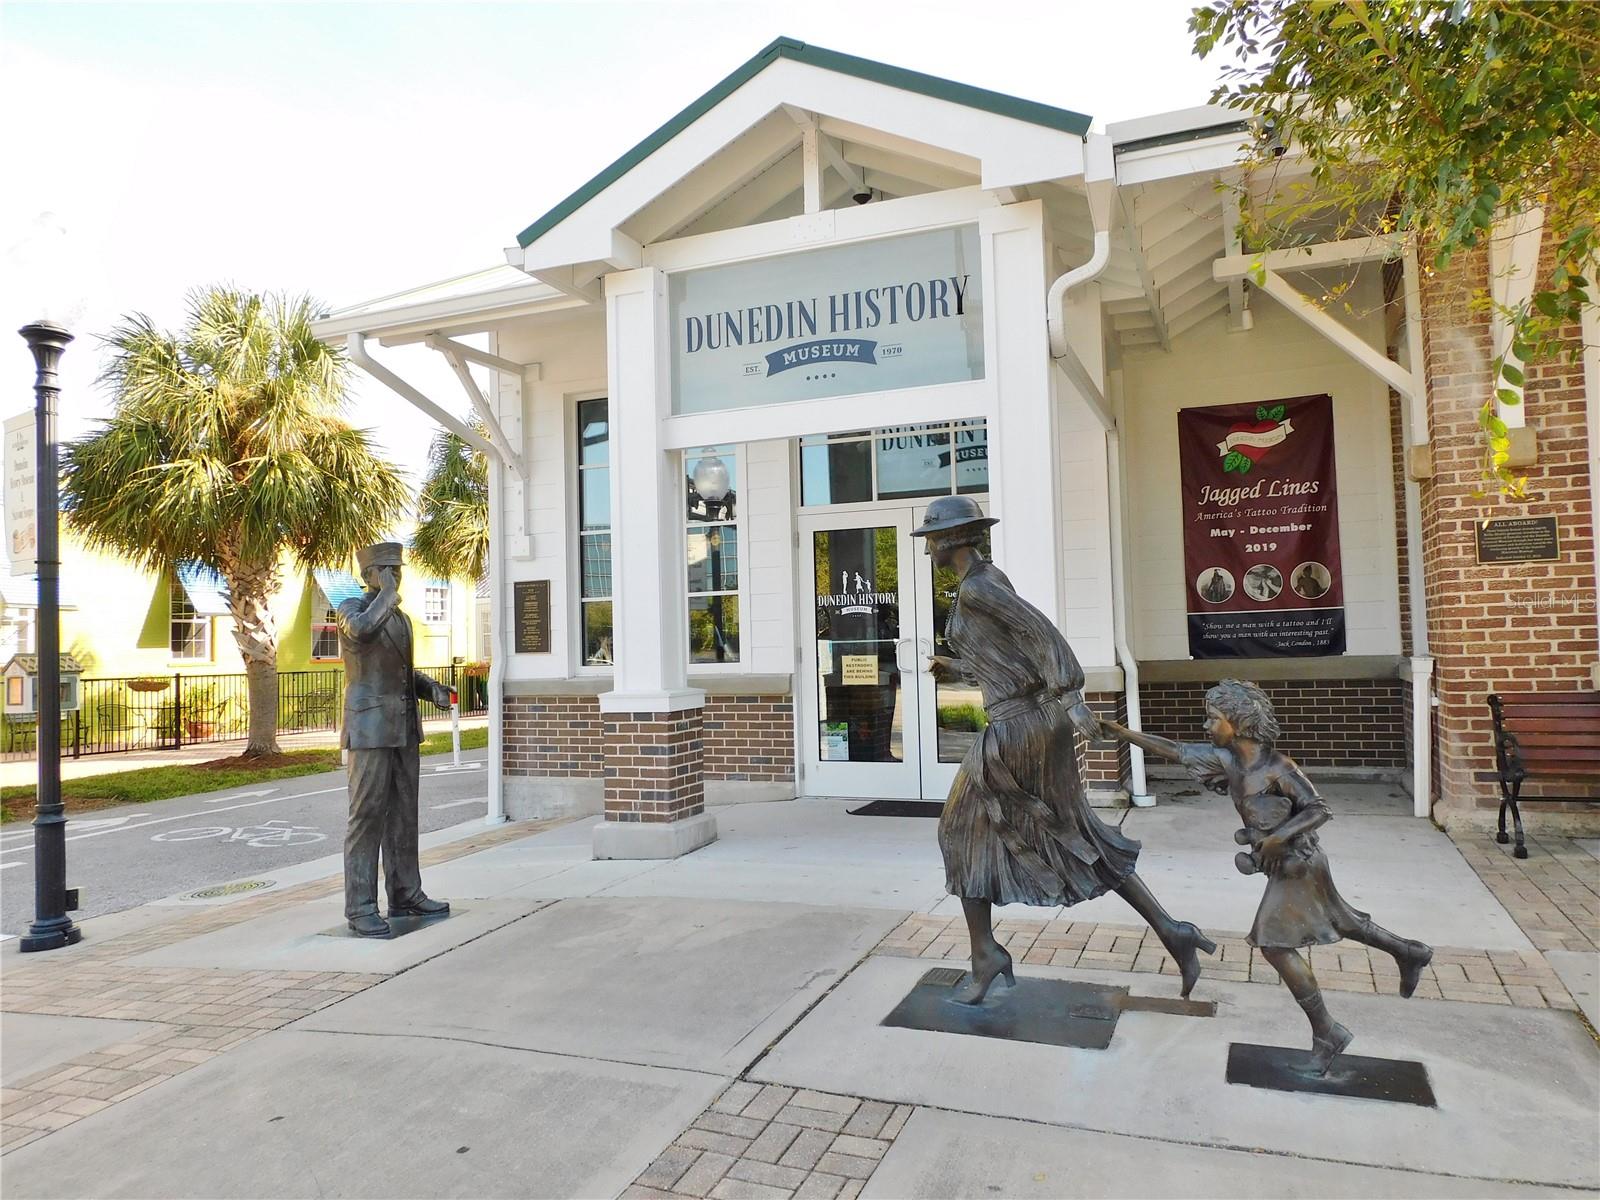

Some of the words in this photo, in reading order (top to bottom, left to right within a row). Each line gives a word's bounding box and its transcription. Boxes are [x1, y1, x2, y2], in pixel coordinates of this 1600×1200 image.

[686, 298, 817, 353] DUNEDIN
[829, 275, 970, 333] HISTORY
[783, 343, 860, 365] MUSEUM
[882, 346, 902, 355] 1970
[744, 365, 761, 373] EST.
[1198, 478, 1265, 506] Jagged
[1267, 478, 1319, 497] Lines
[1194, 509, 1241, 522] America's
[1244, 508, 1277, 517] Tattoo
[1280, 503, 1327, 514] Tradition
[1210, 528, 1235, 538] May
[1250, 523, 1312, 534] December
[1245, 543, 1277, 553] 2019
[818, 594, 856, 606] DUNEDIN
[859, 592, 897, 605] HISTORY
[1258, 620, 1274, 628] with
